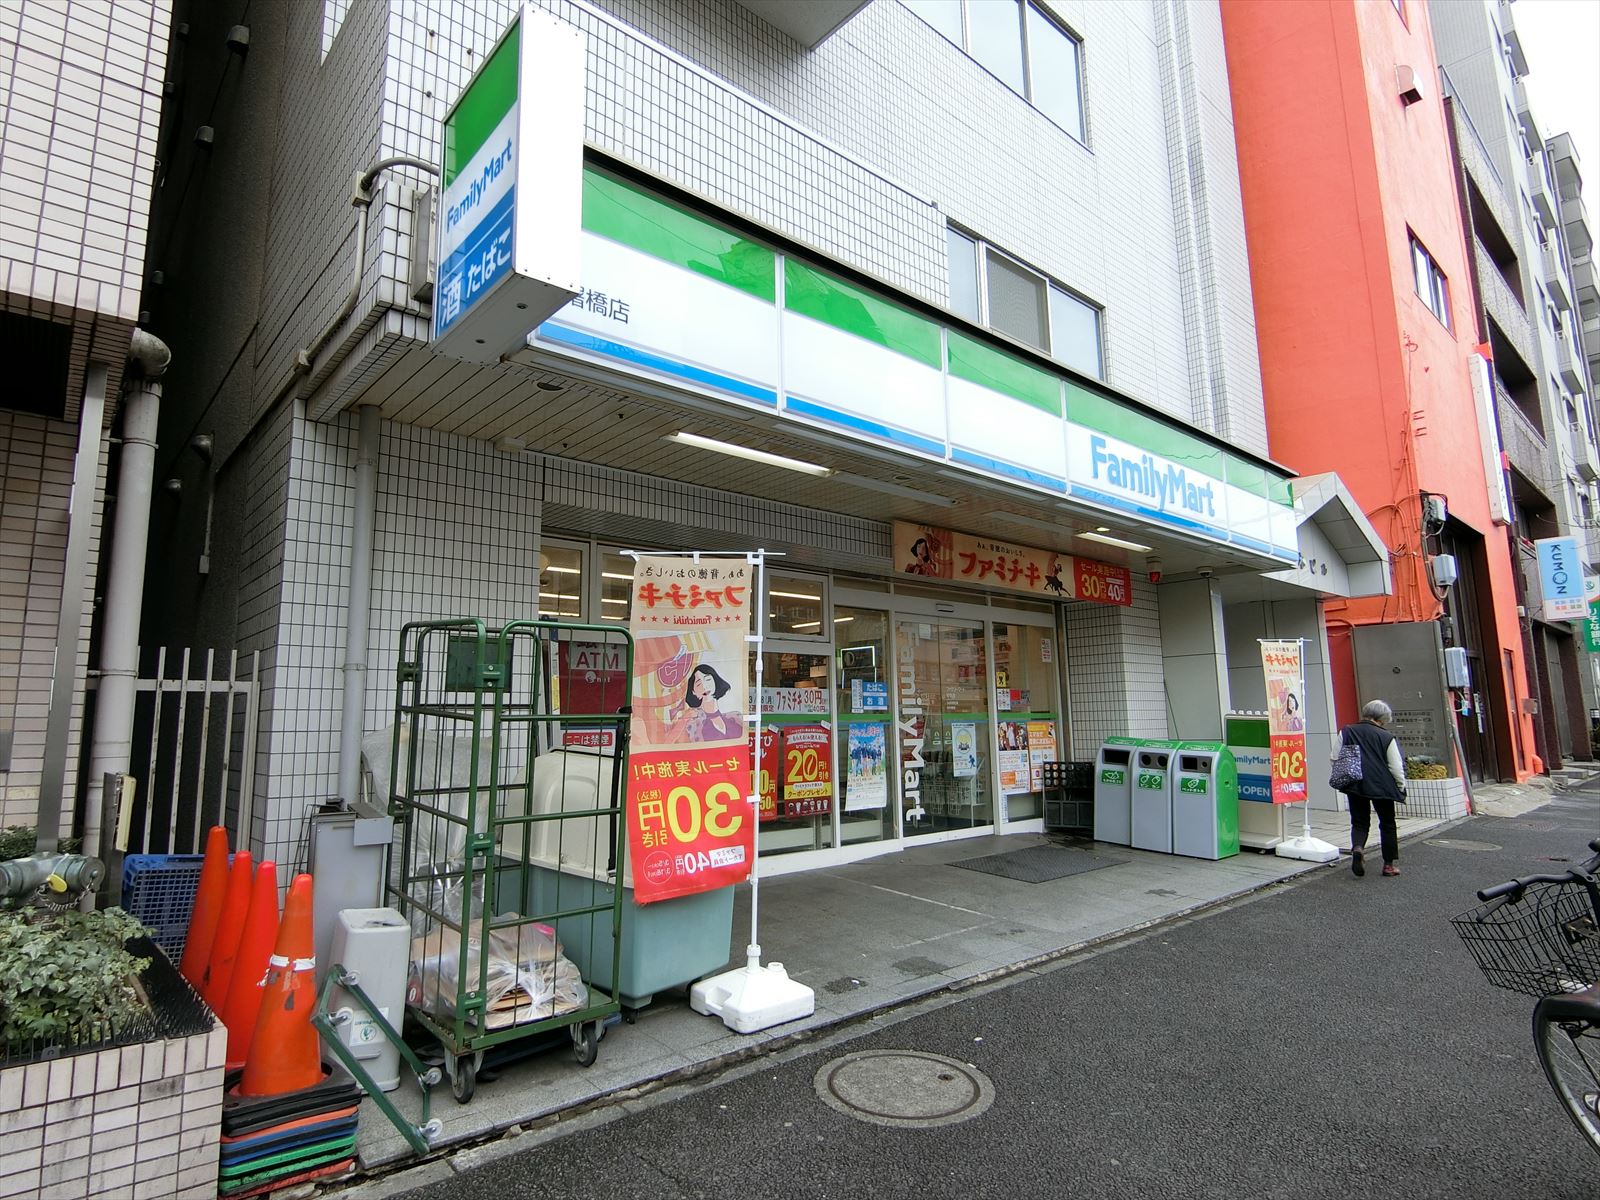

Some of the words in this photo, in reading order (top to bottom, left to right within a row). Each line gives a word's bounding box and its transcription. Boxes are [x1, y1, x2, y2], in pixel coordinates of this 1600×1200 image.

[446, 137, 512, 234] FamilyMart
[440, 271, 462, 328] 酒
[466, 227, 511, 299] たばこ
[1090, 434, 1215, 517] FamilyMart
[958, 551, 1041, 587] ファミチキ
[1550, 543, 1568, 595] KUMON
[576, 651, 619, 669] ATM
[899, 627, 926, 822] FamilyMart
[787, 749, 818, 782] 20
[1234, 755, 1271, 766] amilyMart
[1242, 785, 1270, 797] OPEN
